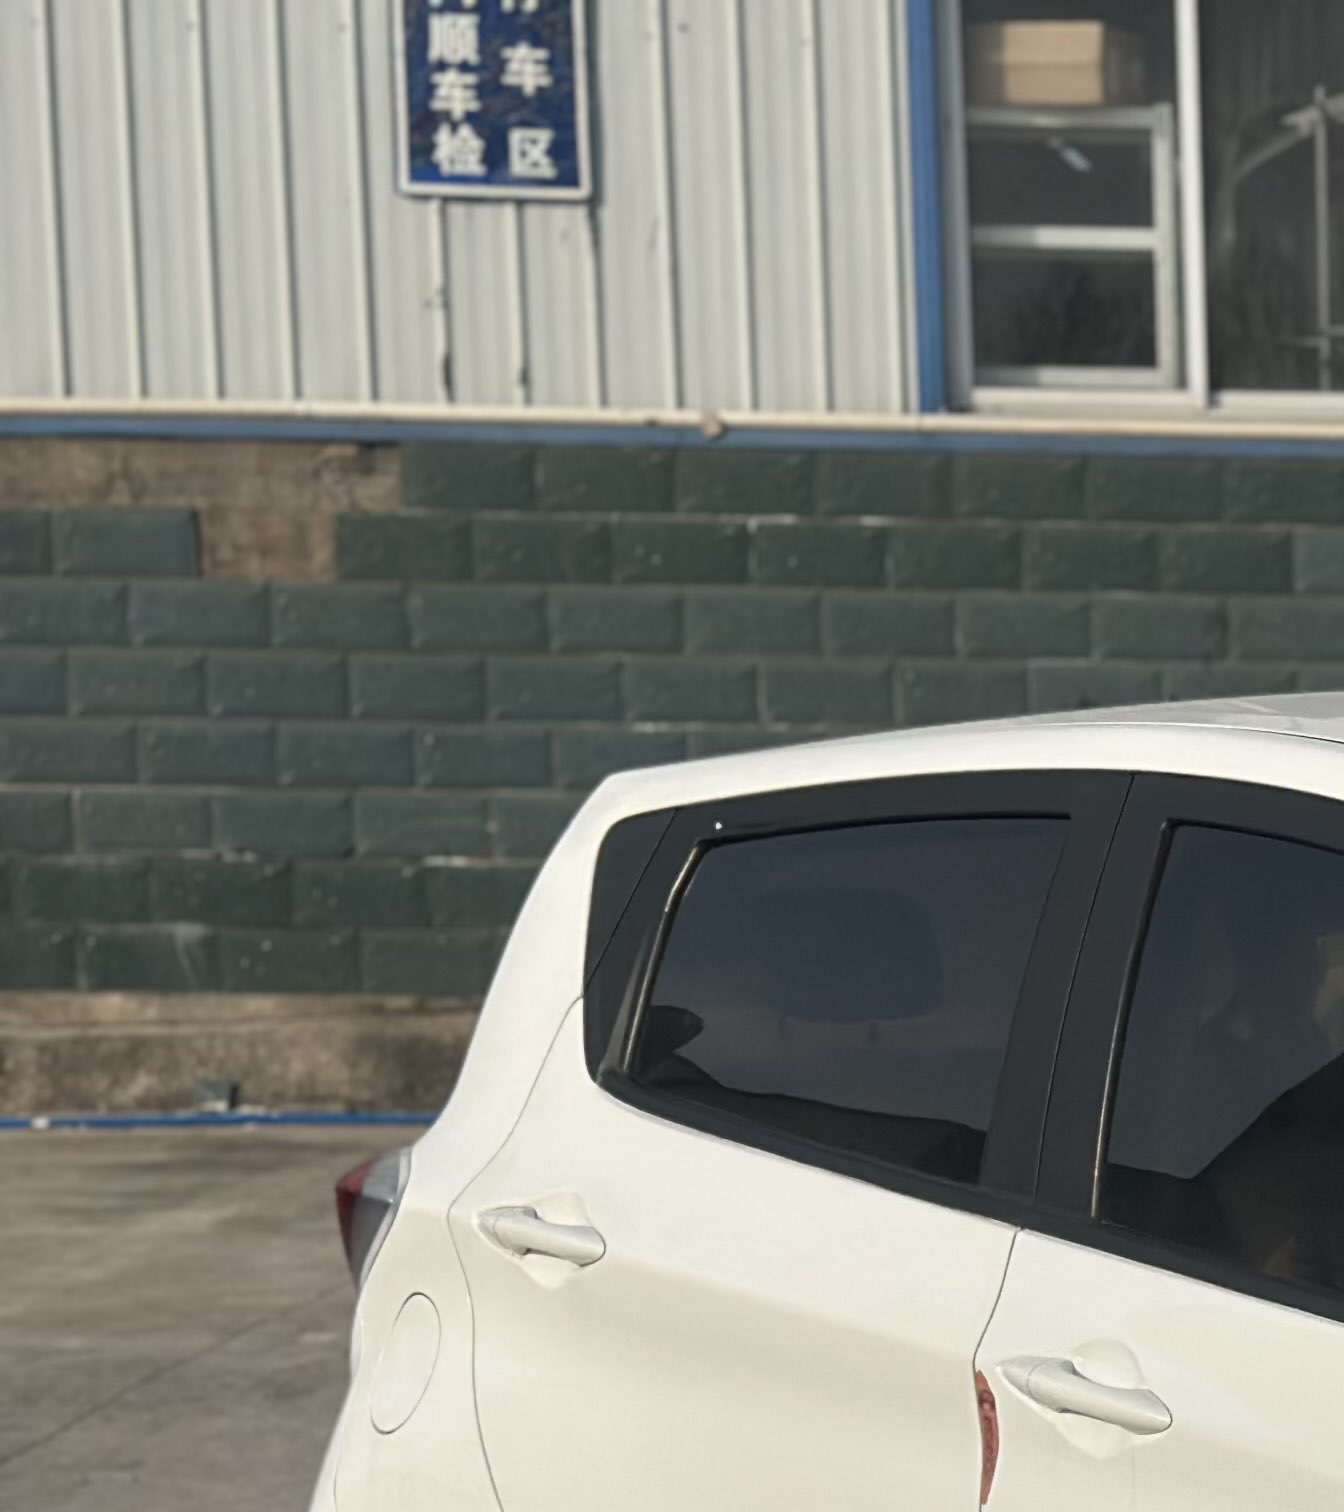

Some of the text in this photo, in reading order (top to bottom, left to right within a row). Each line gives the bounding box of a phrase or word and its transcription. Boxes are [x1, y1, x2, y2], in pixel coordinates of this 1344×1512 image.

[427, 0, 486, 177] 顺车检
[500, 0, 558, 180] 车区
